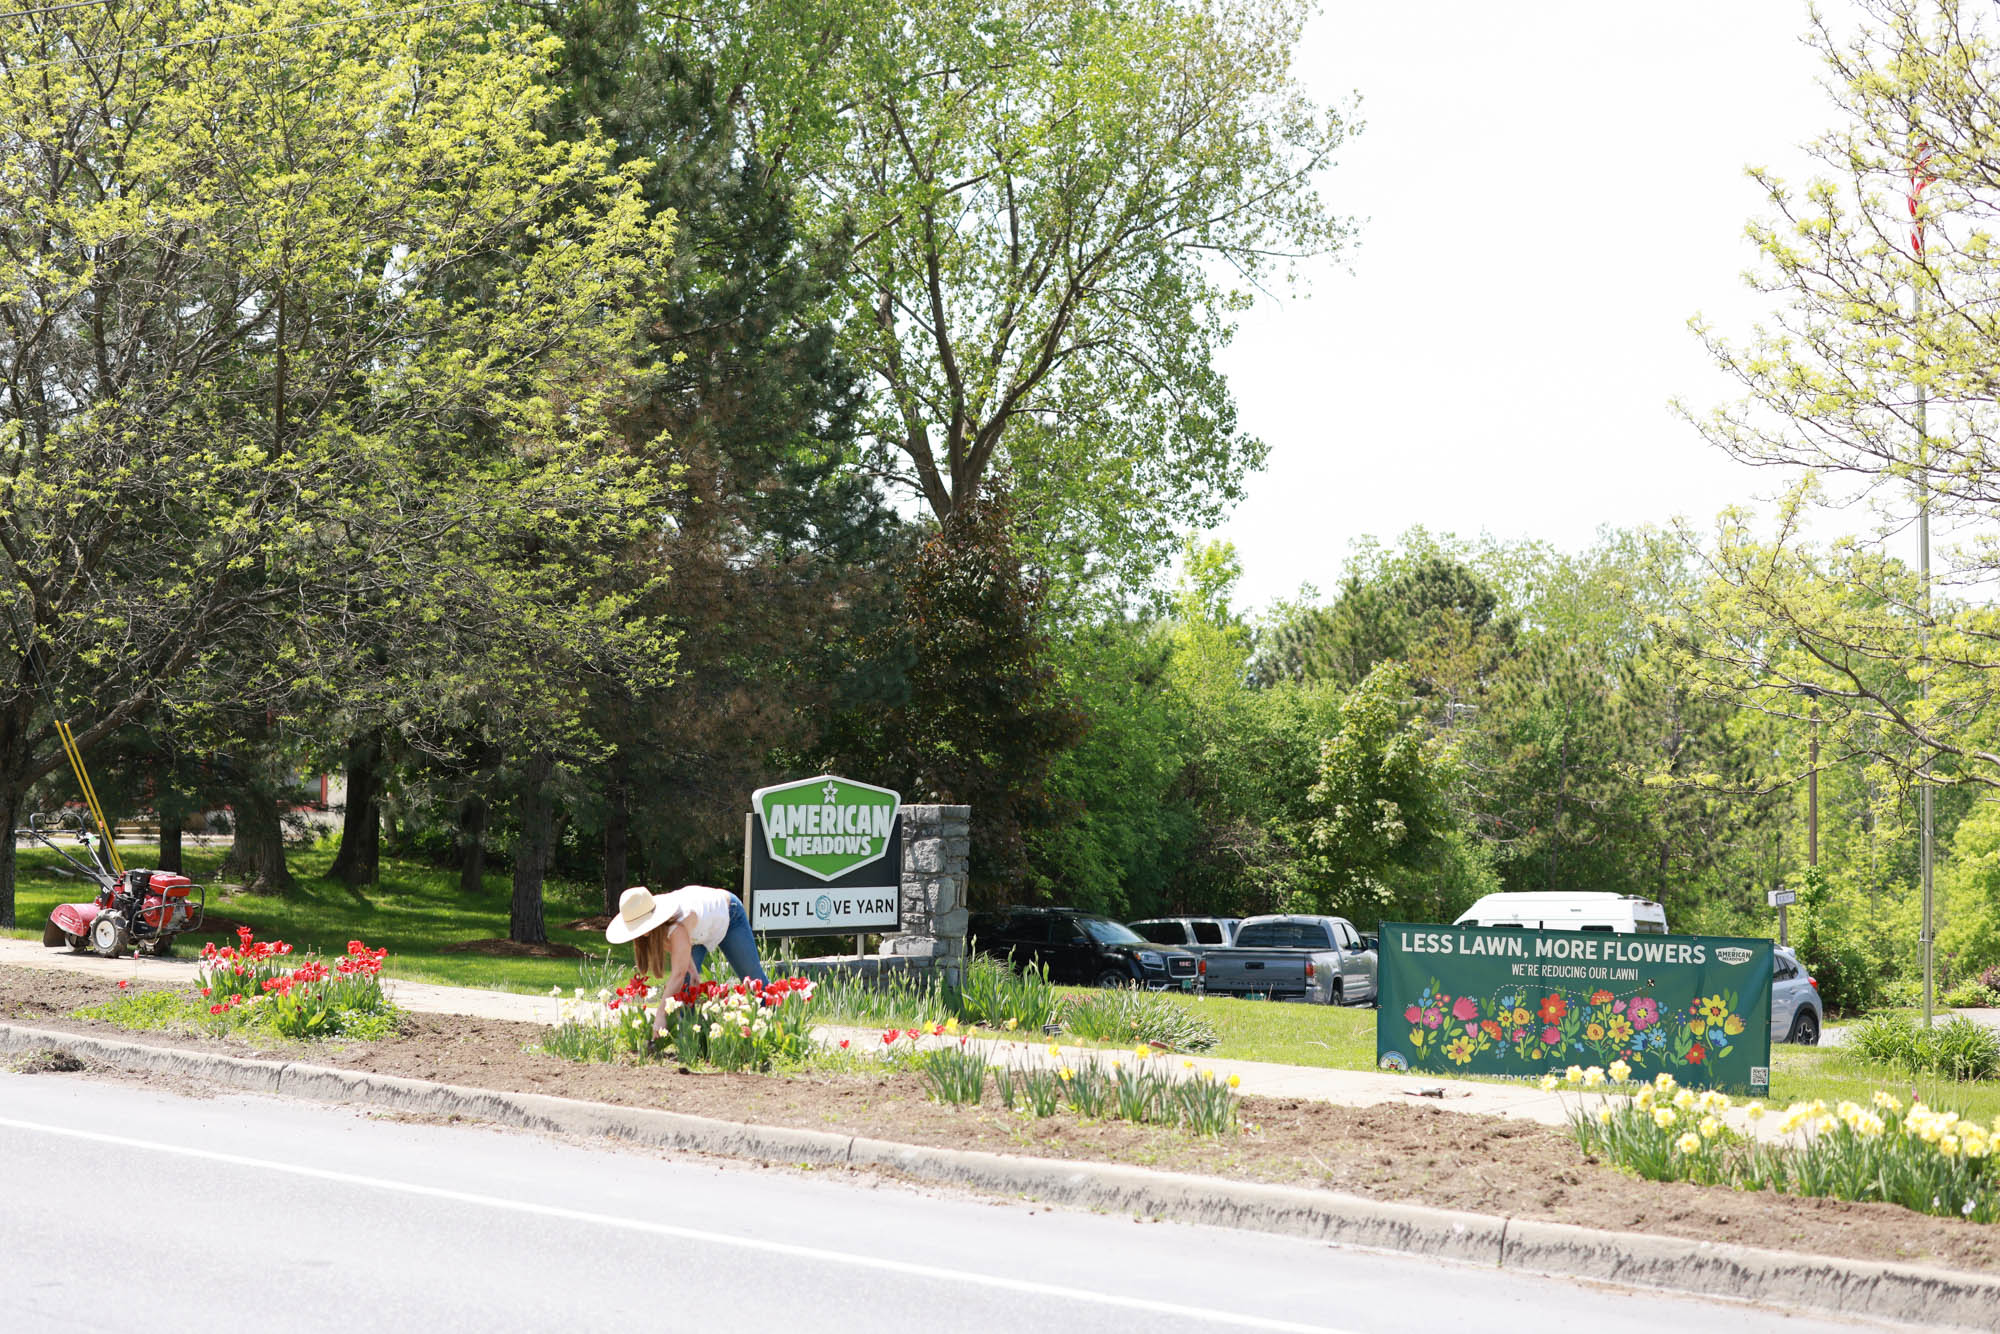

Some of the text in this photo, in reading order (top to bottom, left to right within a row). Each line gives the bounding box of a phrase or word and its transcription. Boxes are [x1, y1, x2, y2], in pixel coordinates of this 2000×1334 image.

[768, 804, 891, 839] AMERICAN
[785, 836, 872, 857] MEADOWS
[759, 901, 800, 918] MUST
[856, 898, 894, 914] YARN
[1401, 932, 1706, 965] LESS LAWN, MORE FLOWERS
[1717, 951, 1751, 959] AMERICAN
[1511, 963, 1639, 981] WE'RE REDUCING OUR LAWN!
